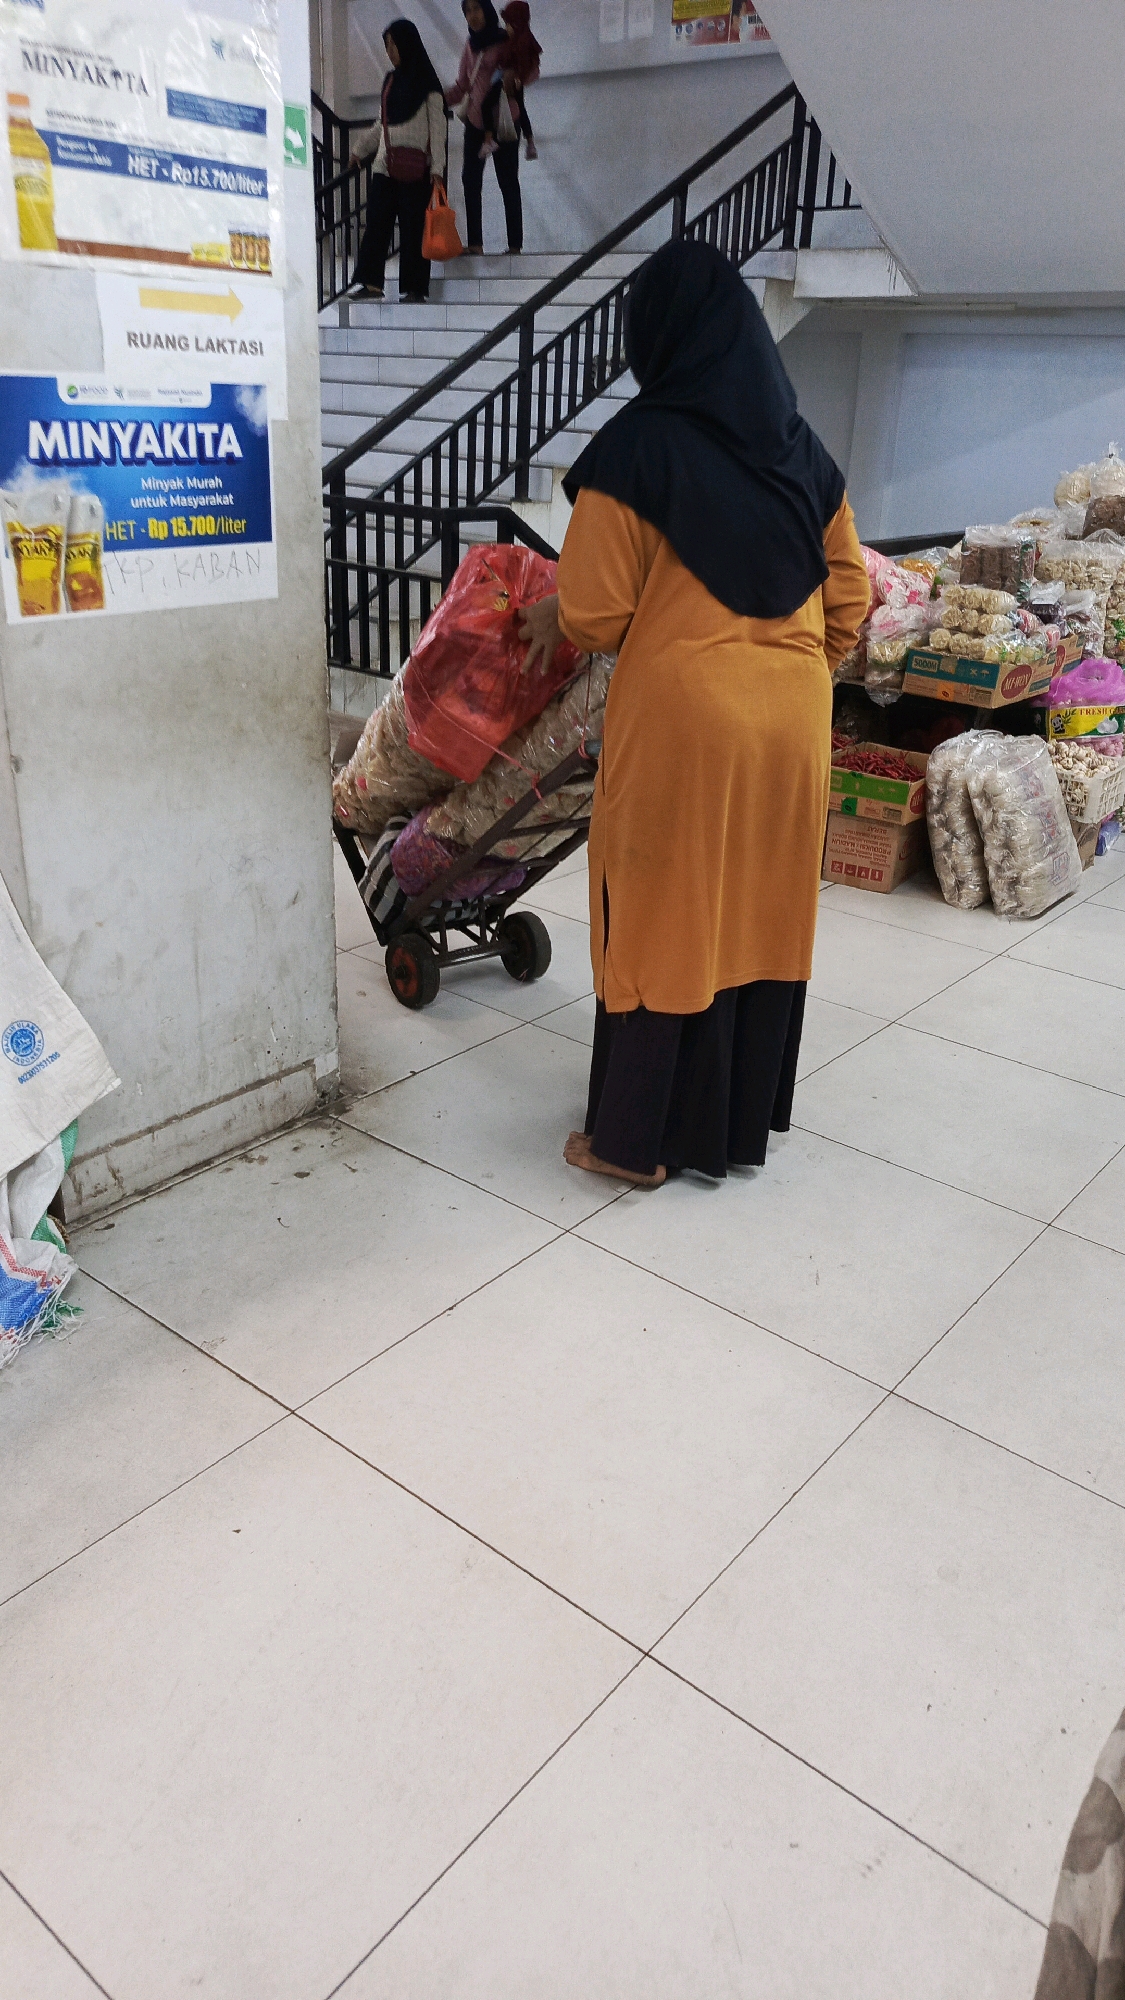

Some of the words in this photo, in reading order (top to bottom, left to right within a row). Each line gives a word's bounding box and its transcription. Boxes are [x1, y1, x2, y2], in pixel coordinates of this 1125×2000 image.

[127, 153, 159, 179] HET
[127, 331, 190, 352] RUANG
[194, 335, 264, 357] LAKTASI
[28, 420, 243, 462] MINYAKITA
[141, 475, 184, 492] Minyak
[186, 475, 223, 490] Murah
[131, 494, 168, 509] untuk
[170, 492, 234, 509] Masyarakat
[106, 520, 136, 541] HET
[147, 517, 168, 540] Rp
[173, 549, 261, 588] KABAN
[1080, 708, 1107, 716] FRESH
[860, 844, 892, 856] PRODUKSI
